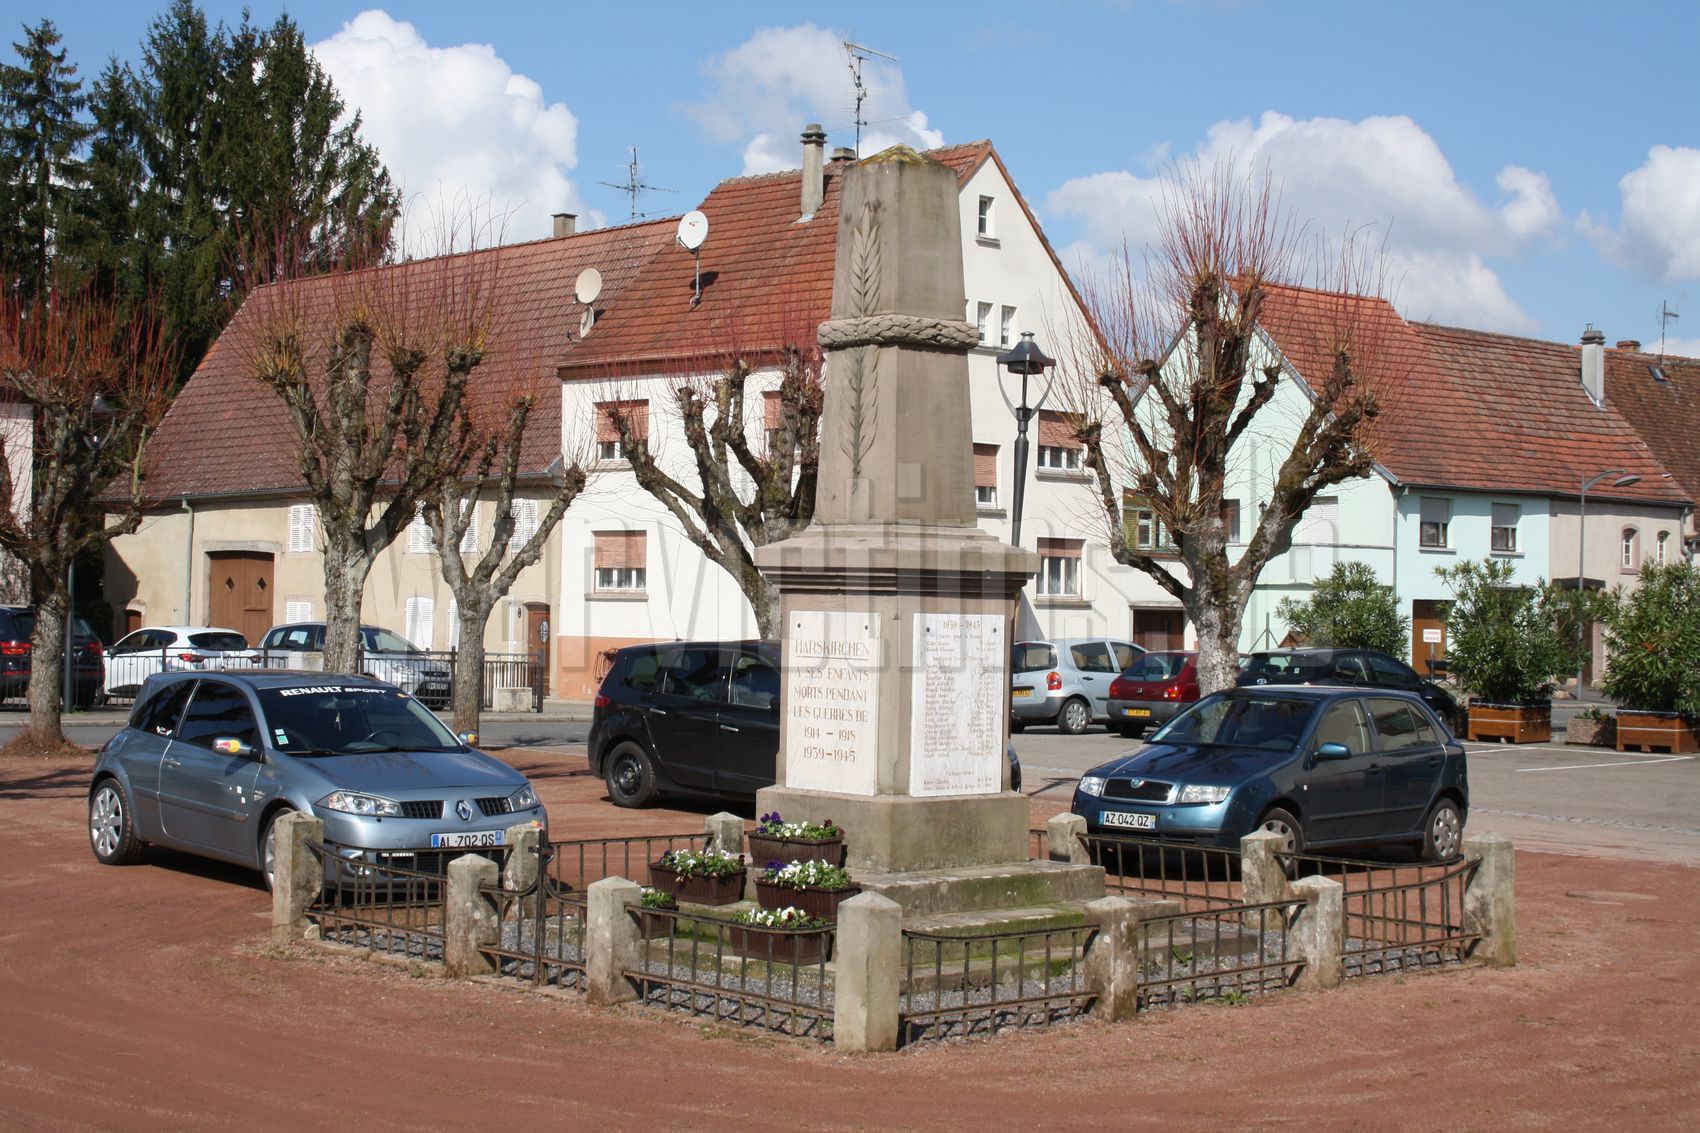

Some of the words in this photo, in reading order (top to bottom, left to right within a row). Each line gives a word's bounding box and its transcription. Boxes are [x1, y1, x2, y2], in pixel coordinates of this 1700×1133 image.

[794, 640, 871, 658] HARSKIRCHEN
[795, 667, 801, 679] A
[805, 668, 823, 680] SES
[827, 669, 870, 682] ENFANTS
[280, 686, 342, 697] RENAULT
[794, 686, 824, 699] MORTS
[826, 687, 869, 702] PENDANT
[793, 705, 811, 718] LES
[813, 707, 853, 722] GUERRES
[855, 709, 869, 723] DE
[804, 726, 821, 739] 1914
[838, 729, 857, 742] 1918
